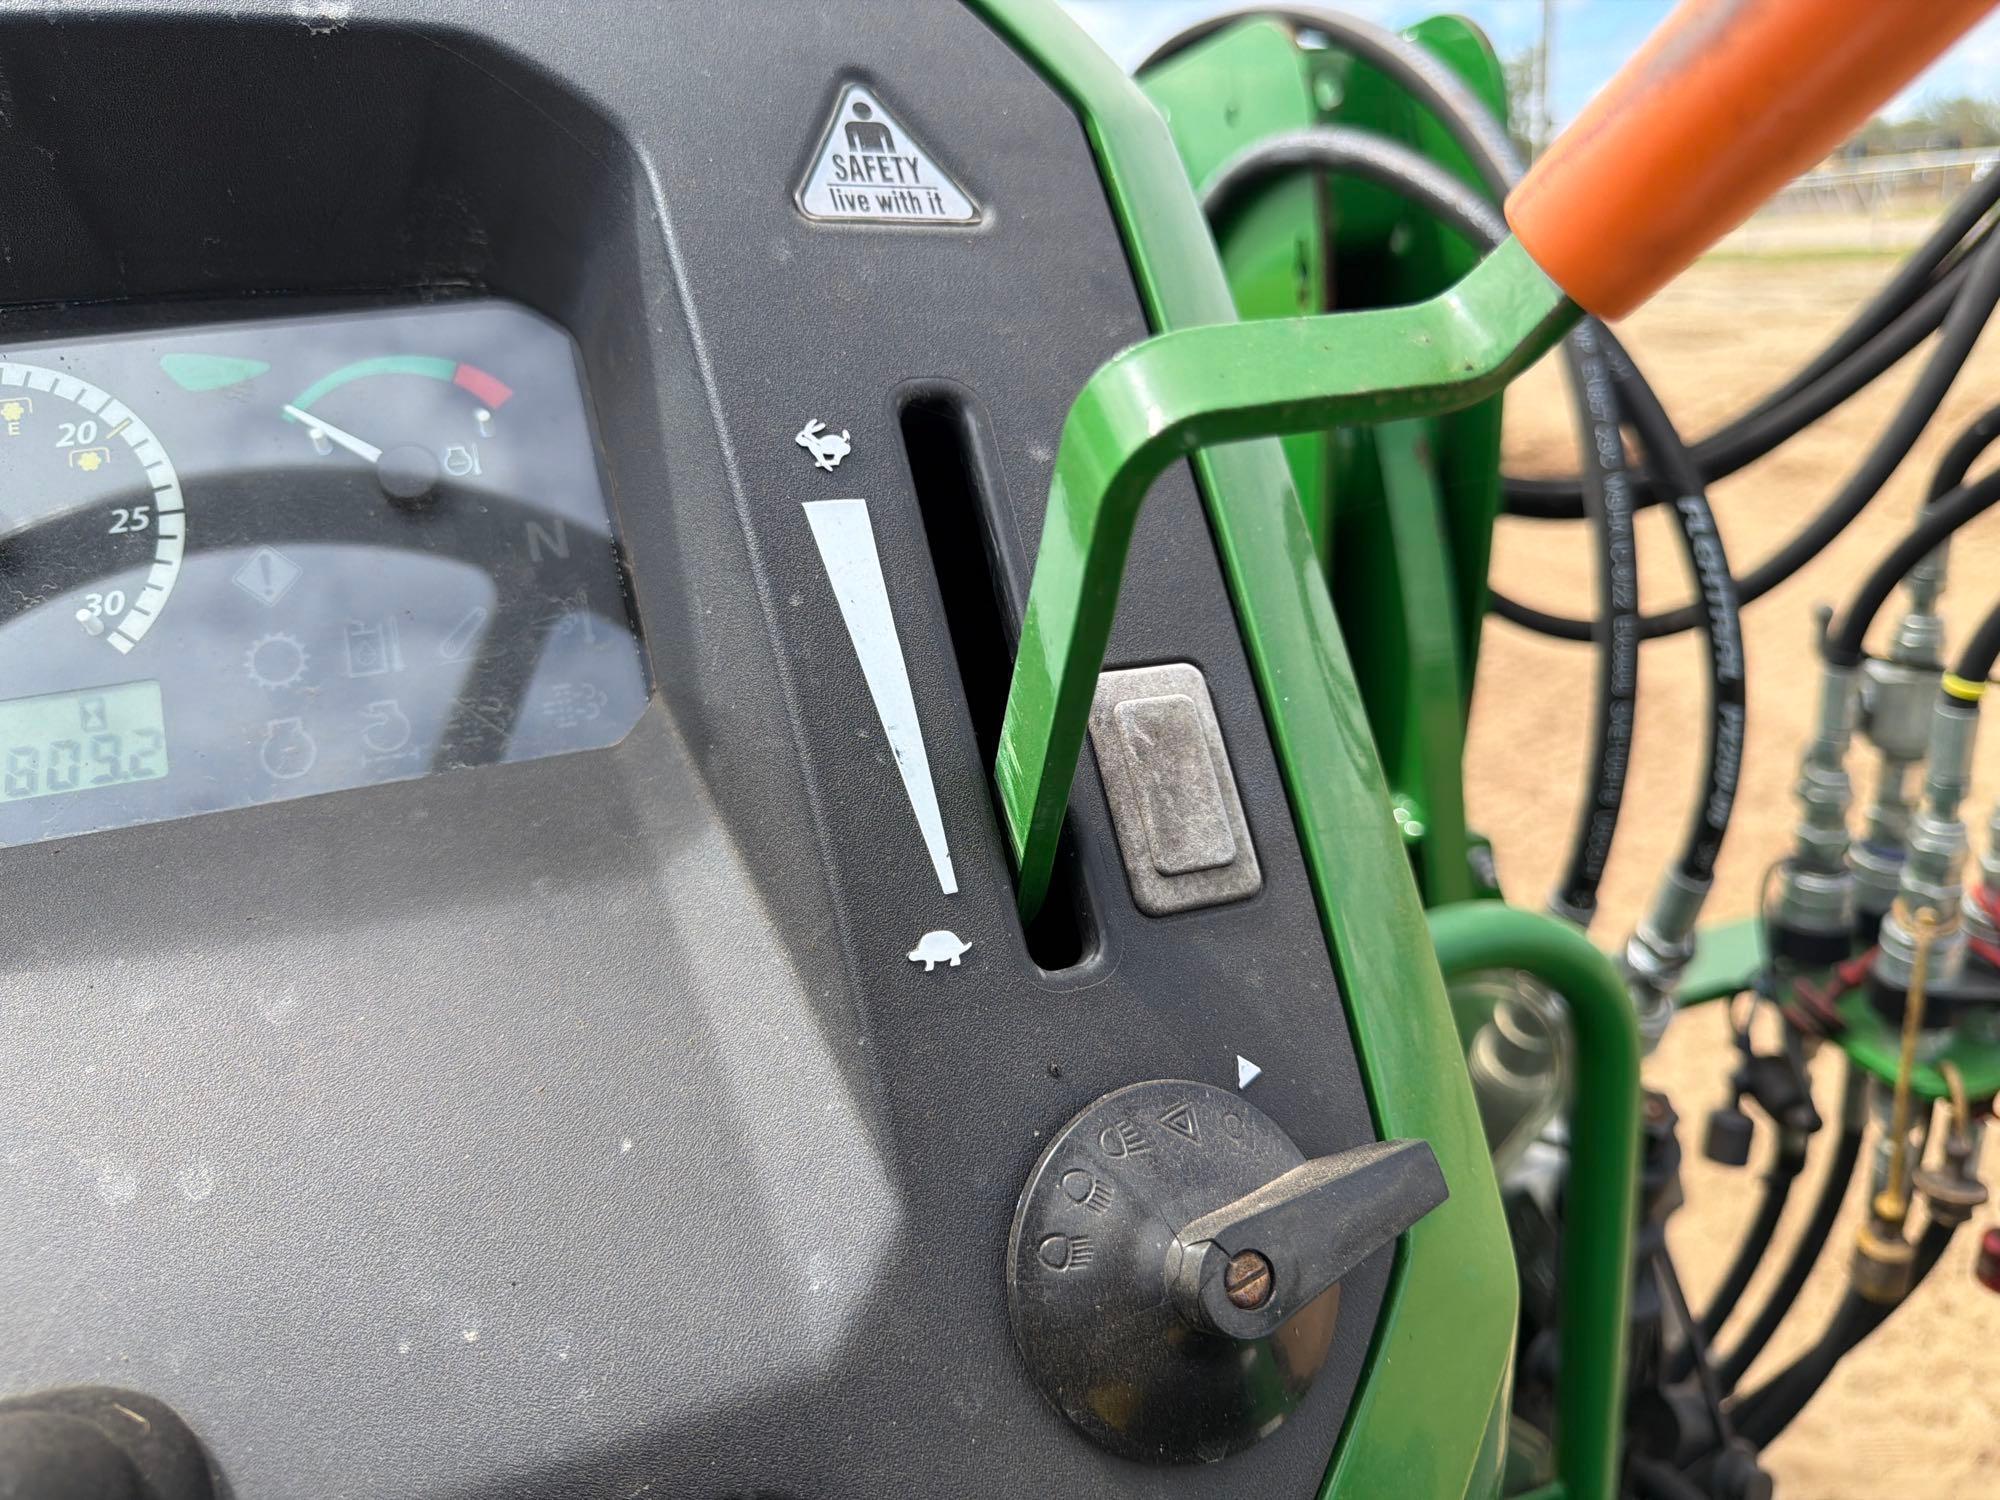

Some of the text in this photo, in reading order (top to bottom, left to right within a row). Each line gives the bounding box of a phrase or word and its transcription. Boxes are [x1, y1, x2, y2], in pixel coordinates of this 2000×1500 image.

[832, 153, 920, 184] SAFETY
[829, 187, 946, 215] live with it
[8, 421, 21, 436] E
[55, 420, 98, 448] 20
[108, 506, 150, 535] 25
[525, 518, 571, 563] N
[84, 590, 126, 617] 30
